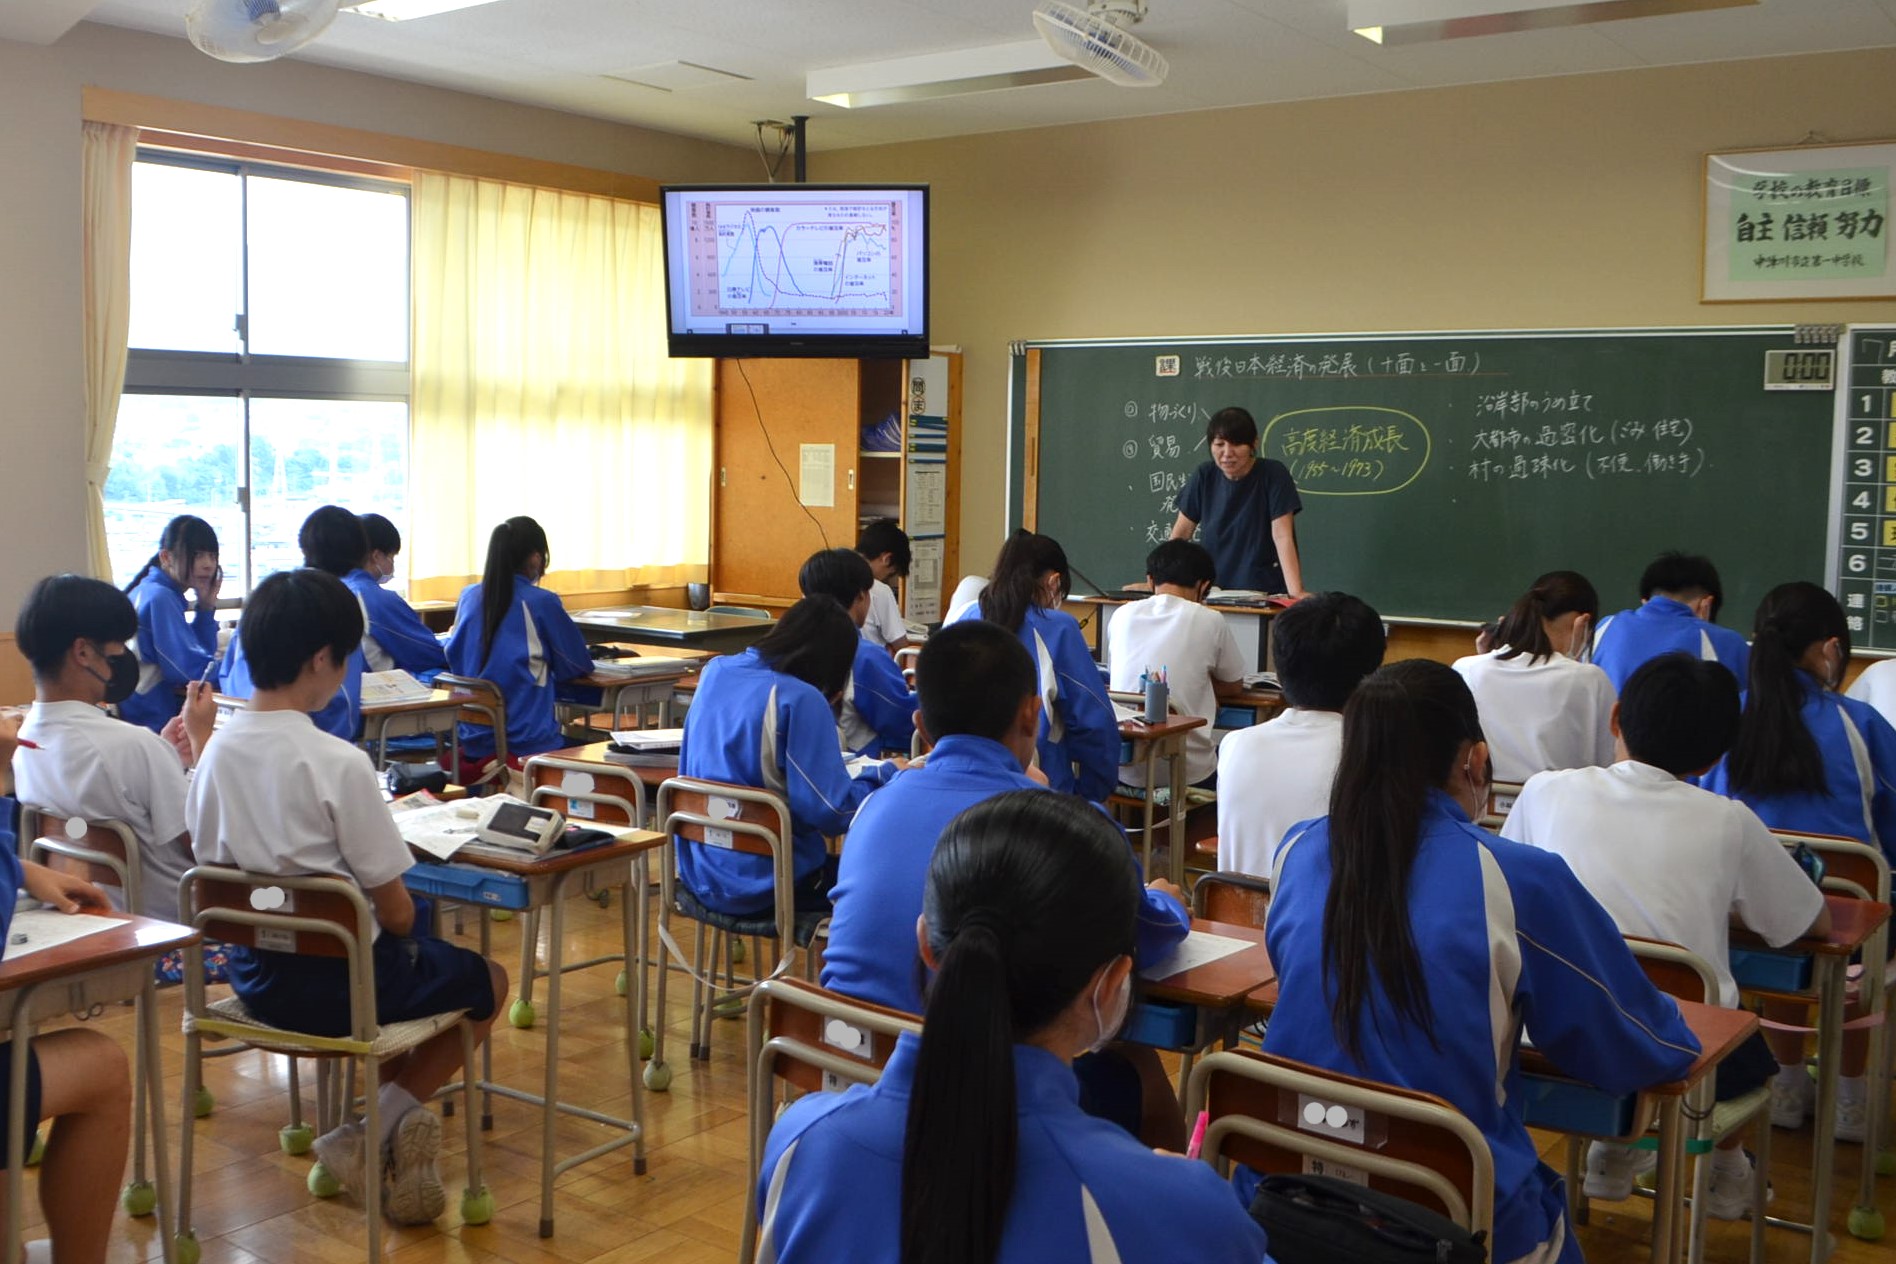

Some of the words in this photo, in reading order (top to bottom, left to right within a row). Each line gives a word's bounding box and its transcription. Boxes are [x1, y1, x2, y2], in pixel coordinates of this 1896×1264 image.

[1736, 212, 1774, 242] 自主
[1783, 213, 1829, 241] 信頼
[1834, 208, 1884, 240] 努力
[1861, 394, 1872, 413] 1
[1281, 424, 1409, 457] 高度経済成長
[1855, 426, 1873, 445] 2
[1148, 434, 1180, 460] 貿易
[1853, 458, 1873, 477] 3
[1851, 490, 1871, 509] 4
[1850, 522, 1870, 540] 5
[1848, 554, 1867, 572] 6
